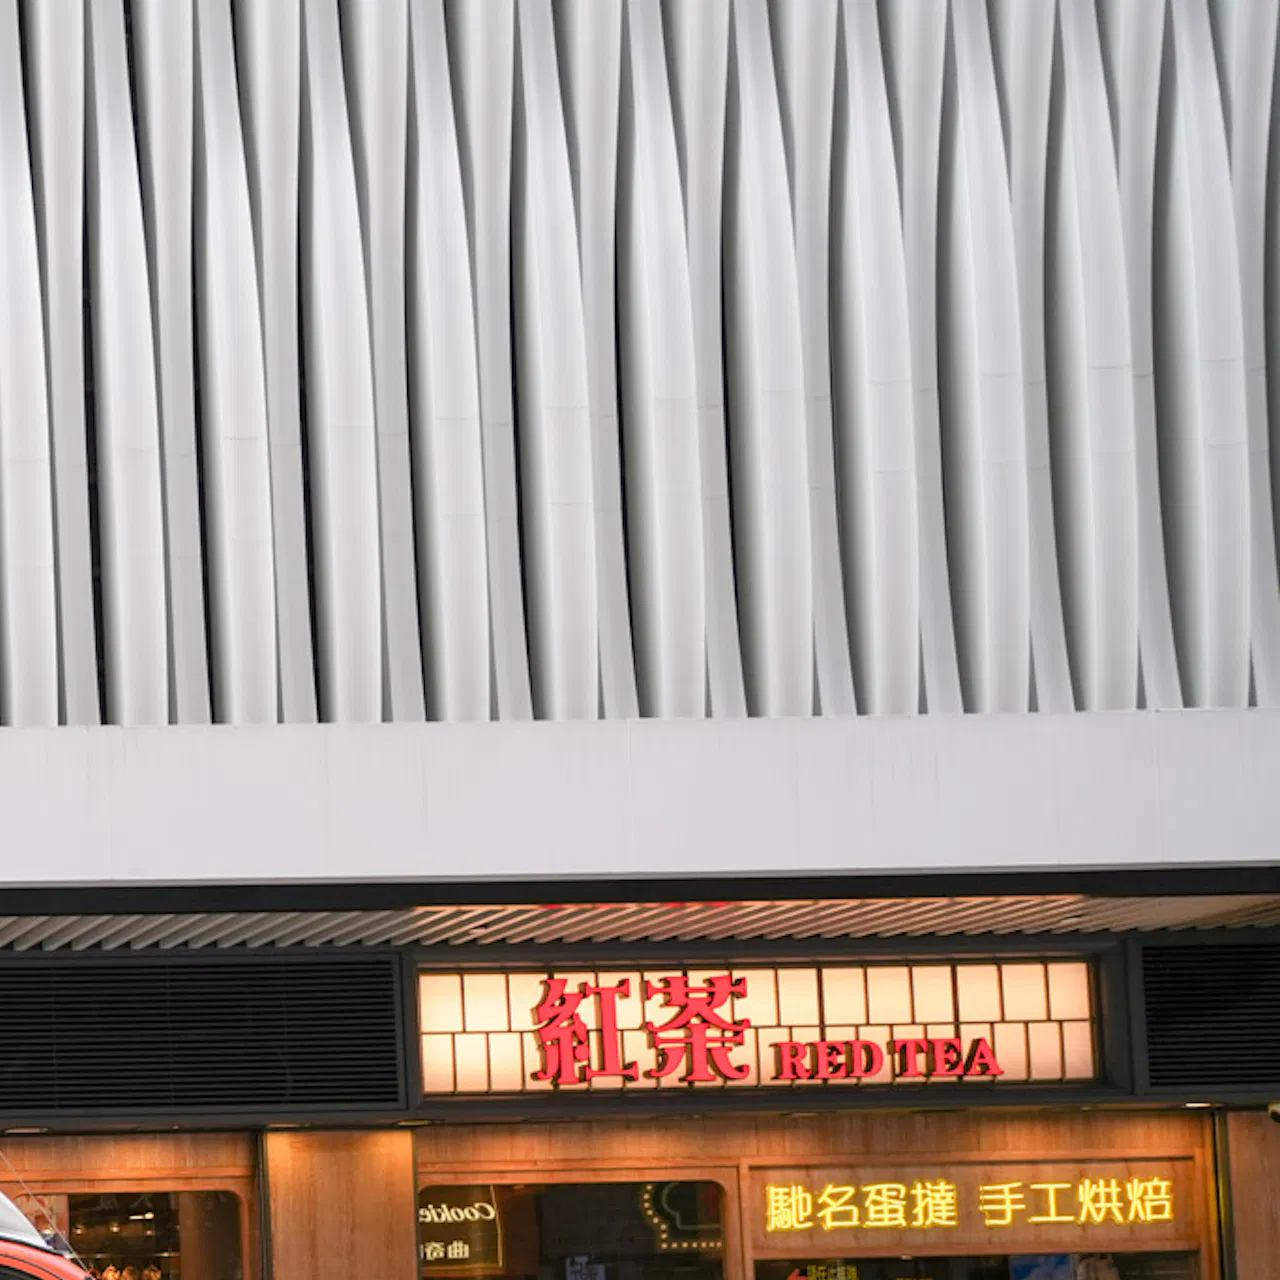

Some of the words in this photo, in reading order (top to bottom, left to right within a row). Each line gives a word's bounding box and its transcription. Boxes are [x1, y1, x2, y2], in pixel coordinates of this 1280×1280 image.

[534, 974, 750, 1085] 紅茶
[773, 1039, 884, 1080] RED
[891, 1036, 1005, 1077] TEA
[766, 1181, 958, 1231] 馳名蛋撻
[979, 1177, 1172, 1226] 手工烘焙
